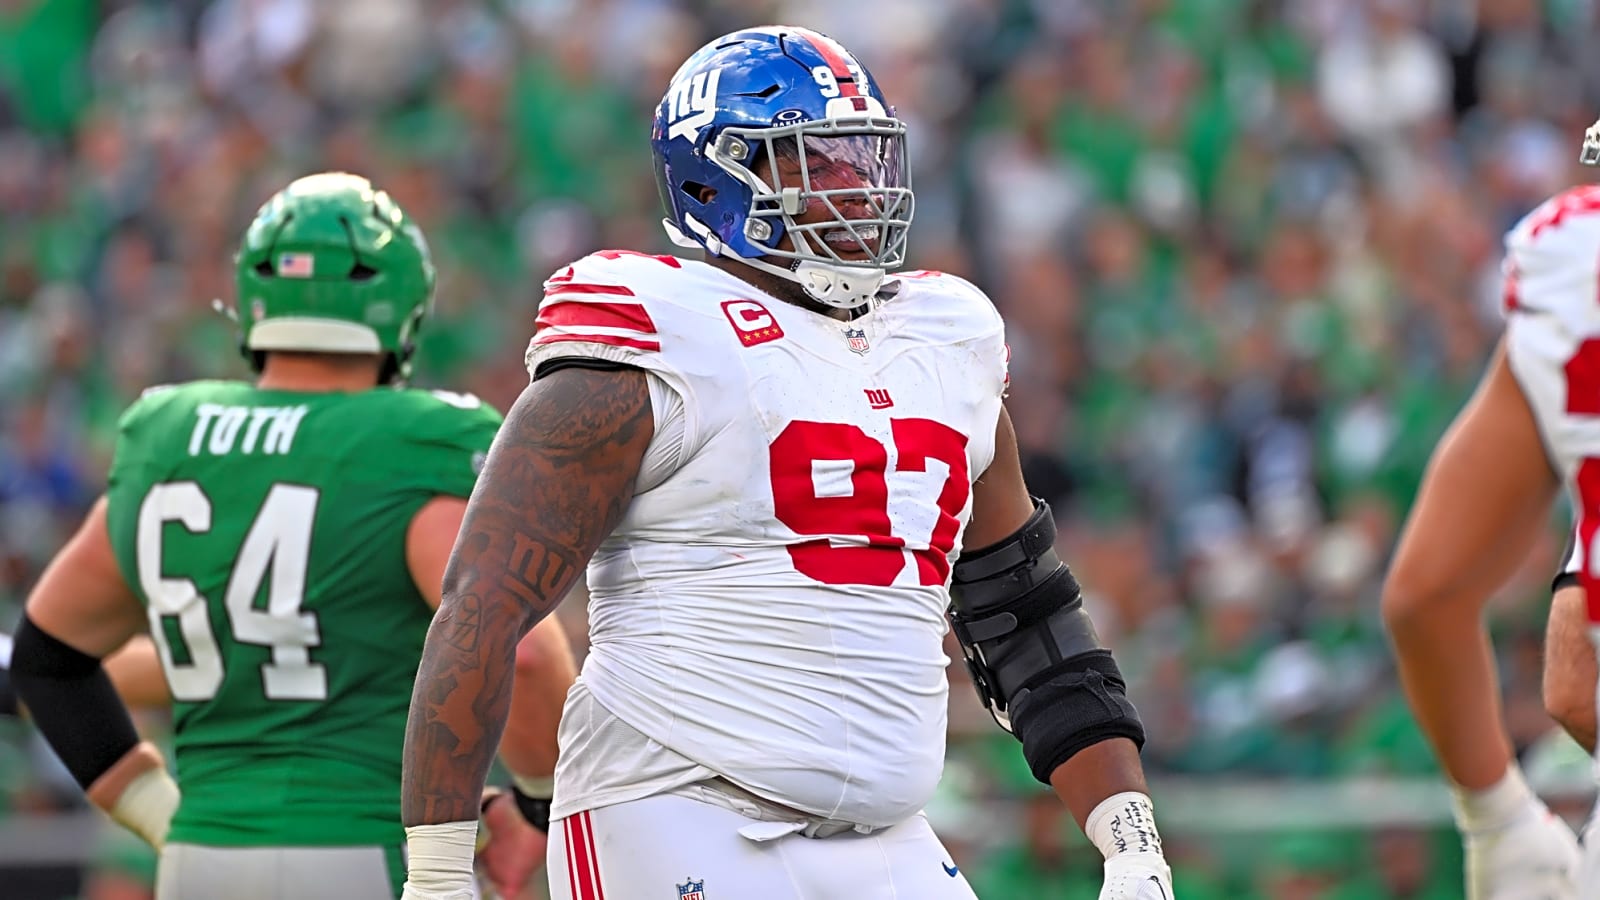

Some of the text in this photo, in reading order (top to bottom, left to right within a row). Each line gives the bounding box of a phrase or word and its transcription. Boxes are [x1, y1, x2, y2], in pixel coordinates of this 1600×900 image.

[726, 300, 773, 332] C
[848, 338, 870, 350] NFL
[187, 403, 309, 456] TOTH
[769, 417, 970, 587] 97
[136, 480, 328, 700] 64
